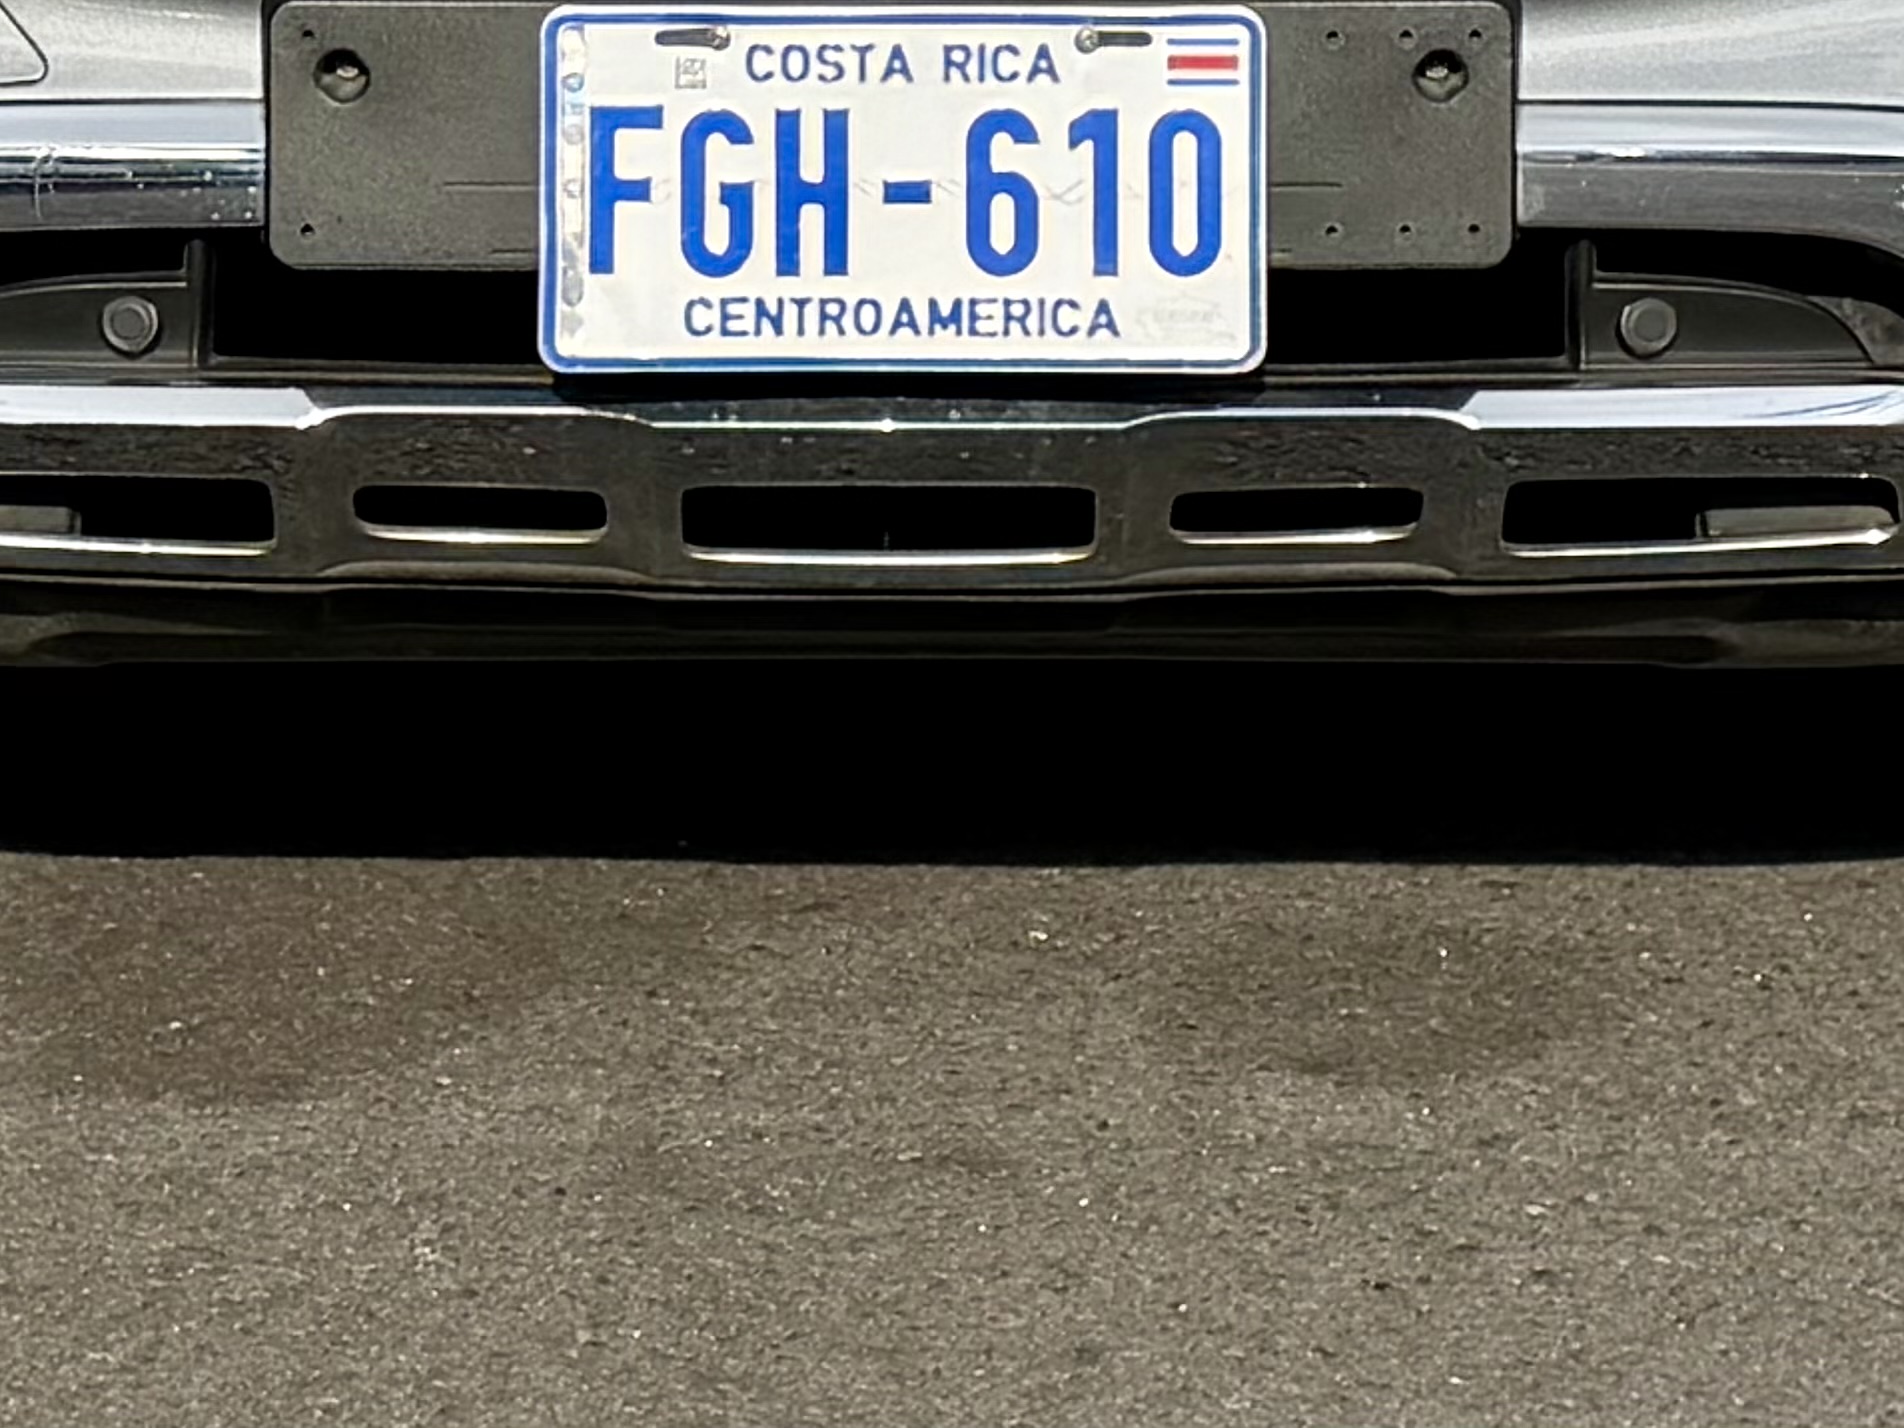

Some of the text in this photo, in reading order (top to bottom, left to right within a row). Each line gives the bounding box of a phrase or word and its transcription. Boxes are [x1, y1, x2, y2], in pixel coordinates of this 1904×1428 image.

[744, 42, 1061, 83] COSTA RICA
[588, 104, 1223, 277] FGH-610
[682, 296, 1121, 338] CENTROAMERICA
